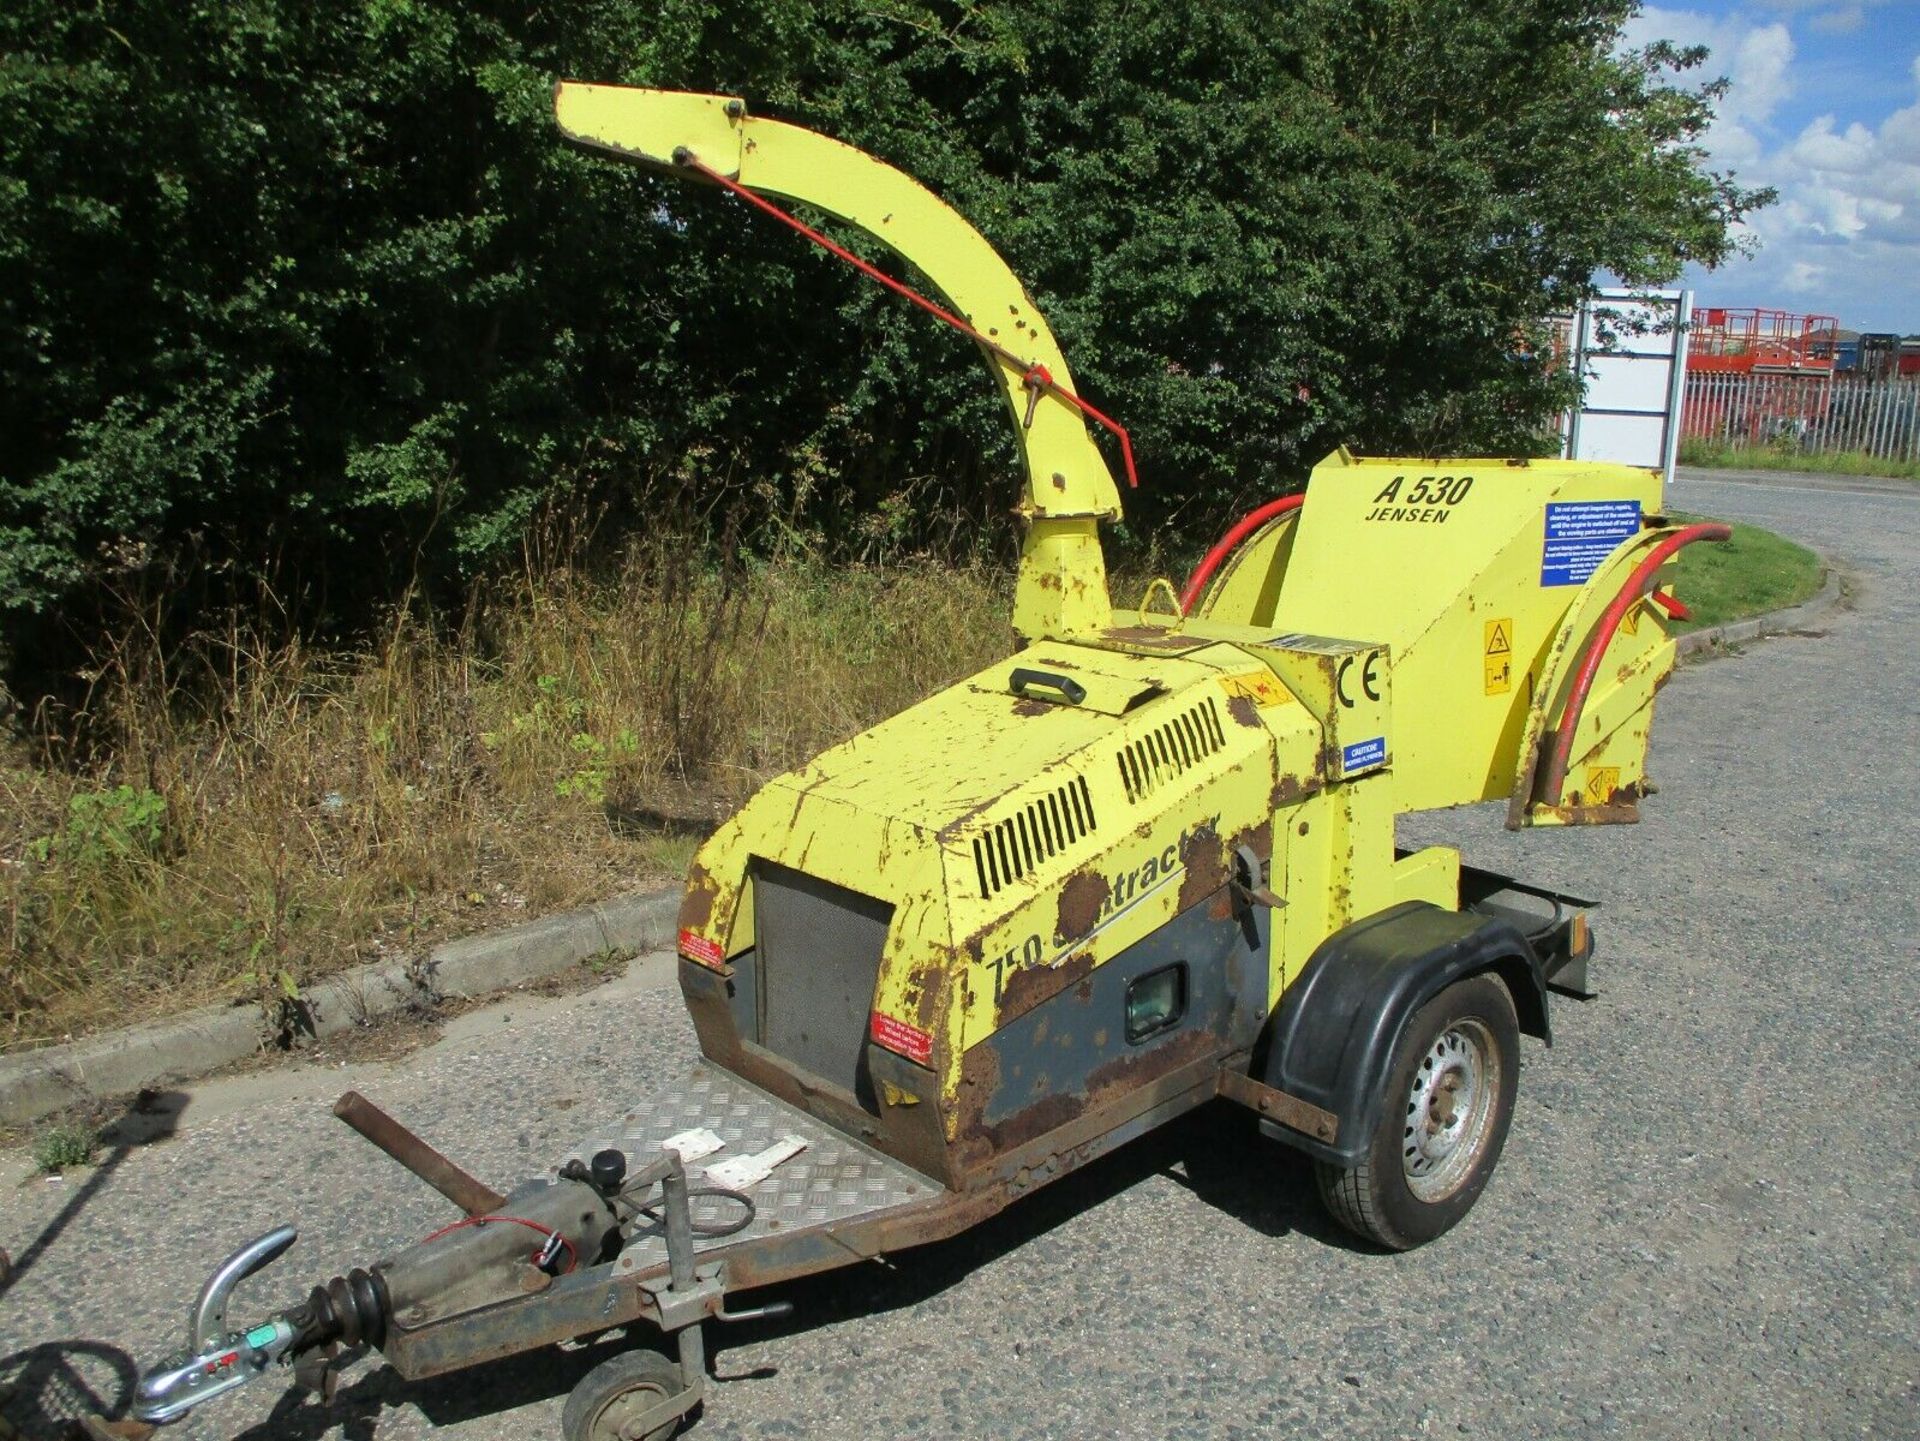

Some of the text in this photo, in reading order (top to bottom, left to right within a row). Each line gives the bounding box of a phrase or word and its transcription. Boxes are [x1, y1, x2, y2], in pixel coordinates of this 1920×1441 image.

[1372, 476, 1474, 505] A 530
[1365, 508, 1450, 523] JENSEN
[1337, 650, 1380, 708] CE
